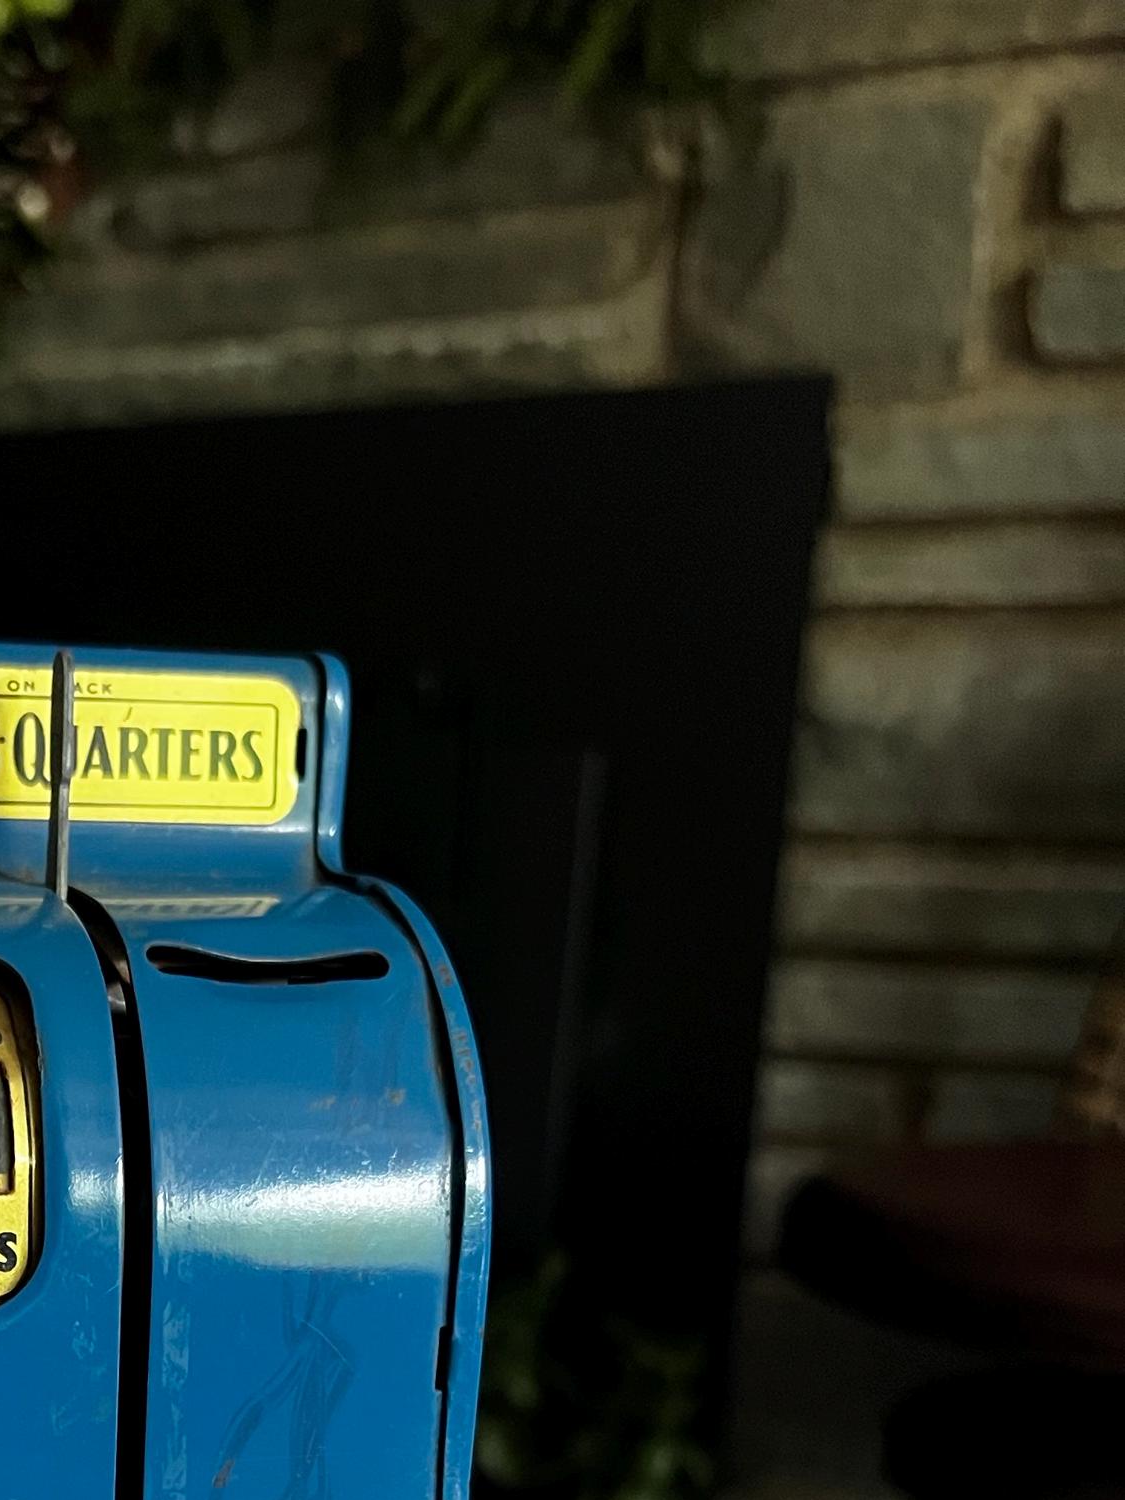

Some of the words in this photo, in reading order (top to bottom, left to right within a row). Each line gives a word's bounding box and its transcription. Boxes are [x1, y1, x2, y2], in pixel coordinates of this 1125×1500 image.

[7, 679, 35, 692] ON
[74, 682, 113, 695] ACK
[13, 711, 264, 788] QARTERS
